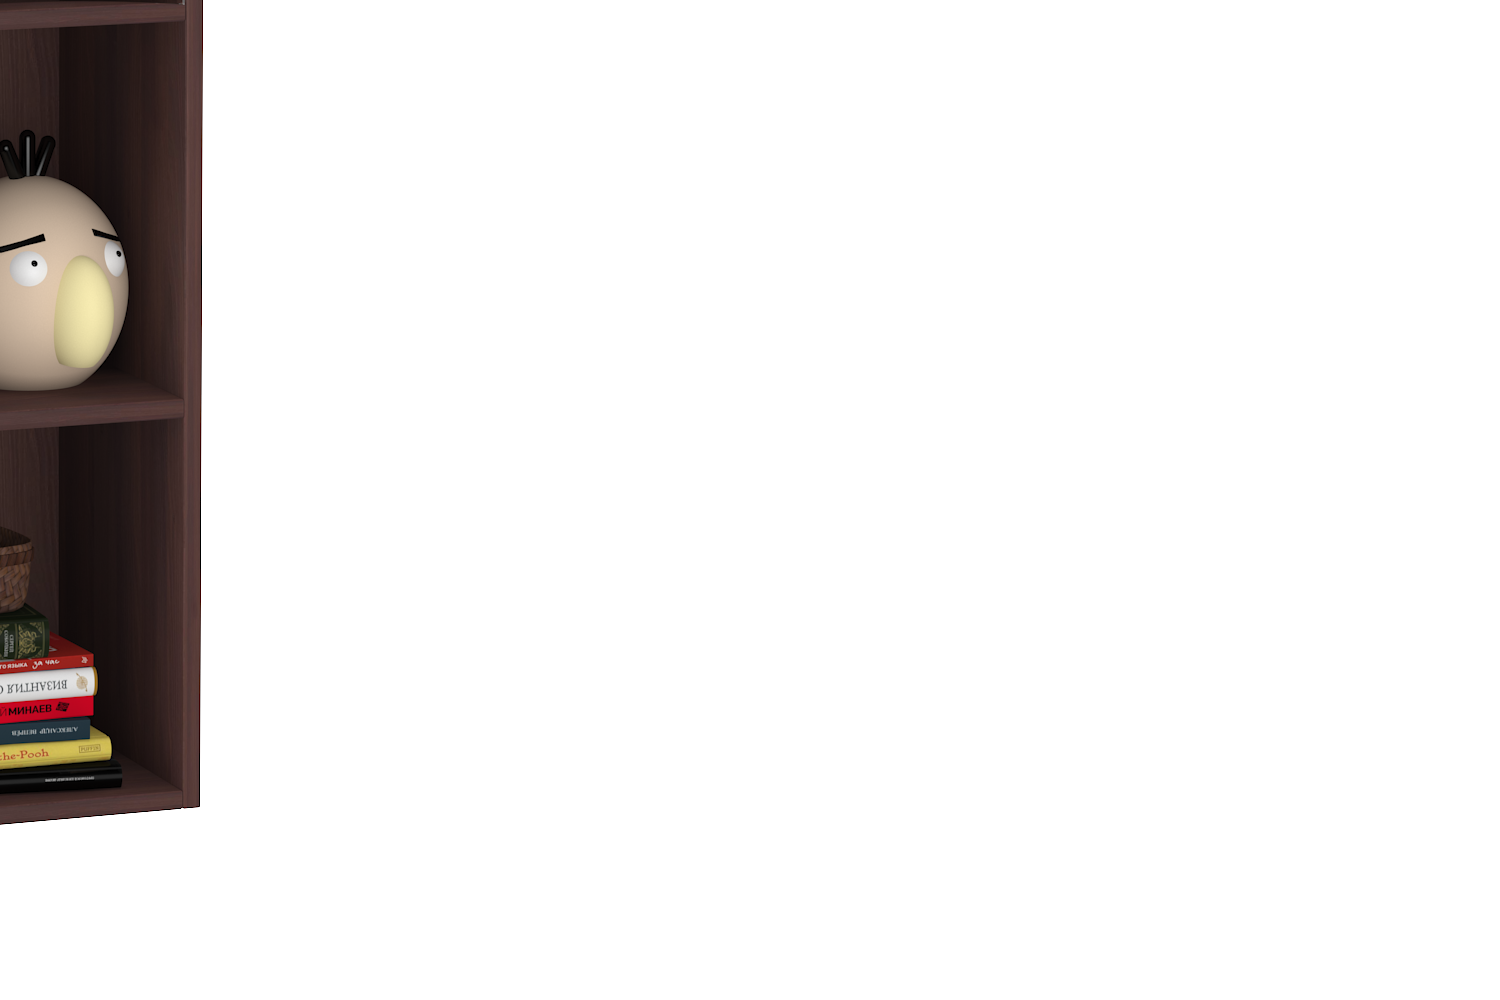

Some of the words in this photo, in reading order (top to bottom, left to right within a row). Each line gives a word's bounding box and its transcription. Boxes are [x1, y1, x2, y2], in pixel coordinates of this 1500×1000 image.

[7, 661, 28, 669] ЯЗЫКА
[31, 660, 43, 670] за
[7, 679, 68, 694] ВИЗАНТИЯ
[8, 704, 52, 716] МИНАЕВ
[39, 726, 79, 735] АЛЕКСАНДР
